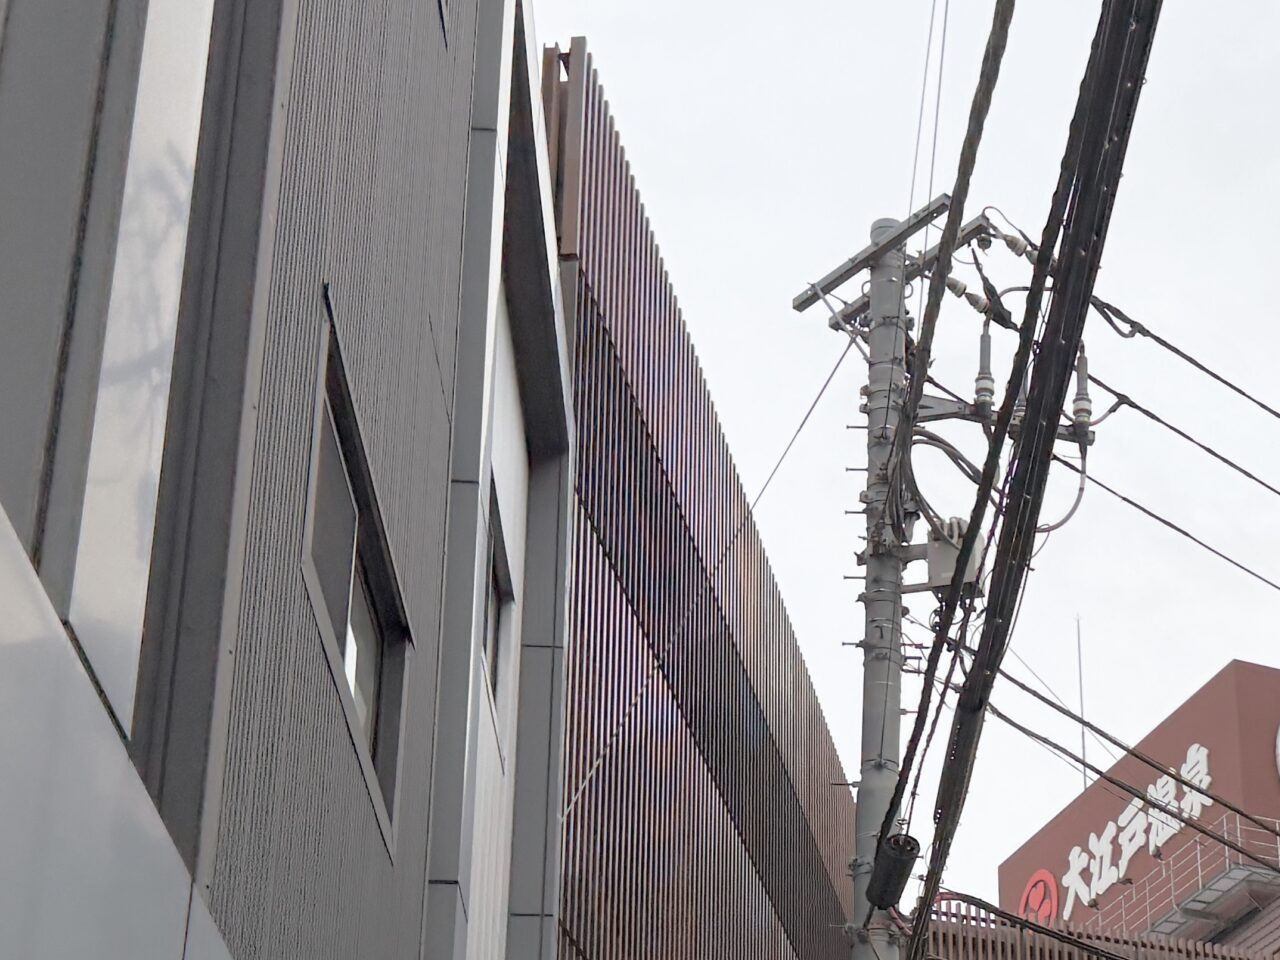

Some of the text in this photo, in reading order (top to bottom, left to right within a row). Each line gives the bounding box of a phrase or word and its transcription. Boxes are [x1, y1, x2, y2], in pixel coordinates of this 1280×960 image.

[1062, 743, 1214, 920] 大江戸温泉
